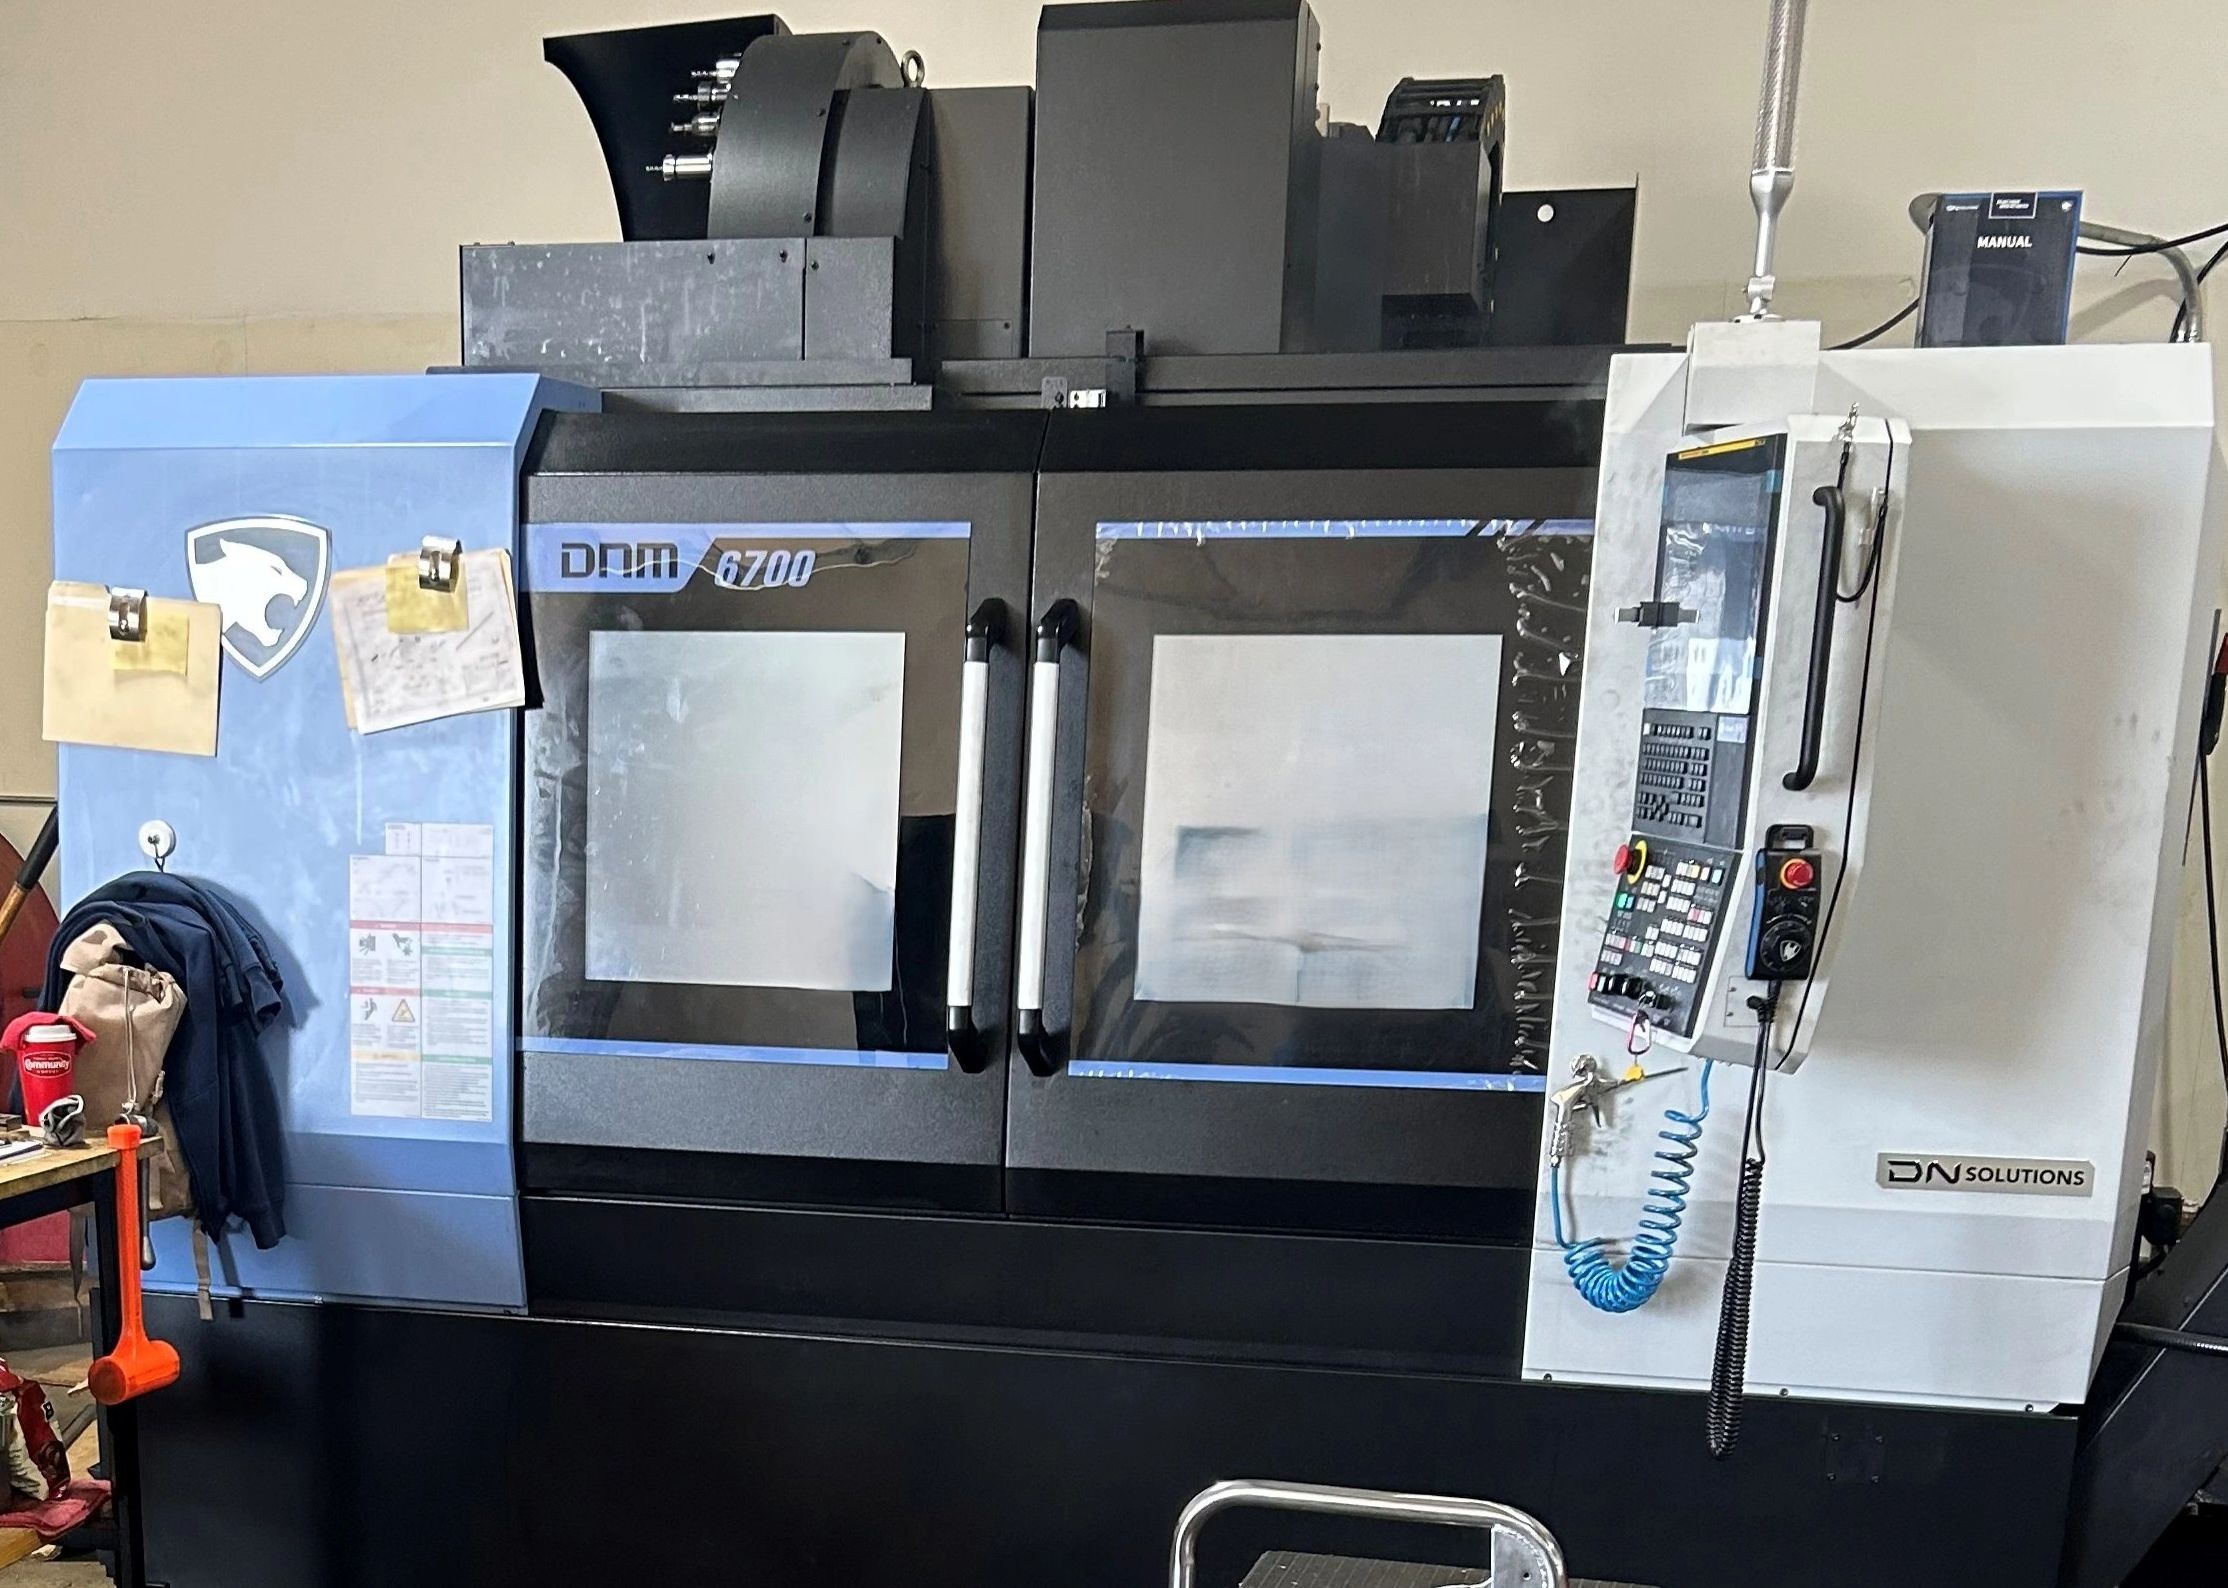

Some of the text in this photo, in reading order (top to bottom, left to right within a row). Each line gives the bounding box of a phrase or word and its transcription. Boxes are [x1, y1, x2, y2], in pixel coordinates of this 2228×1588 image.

[1977, 235, 2032, 248] MANUAL
[561, 542, 816, 588] DNM 6700
[1887, 1159, 2085, 1186] DN SOLUTIONS
